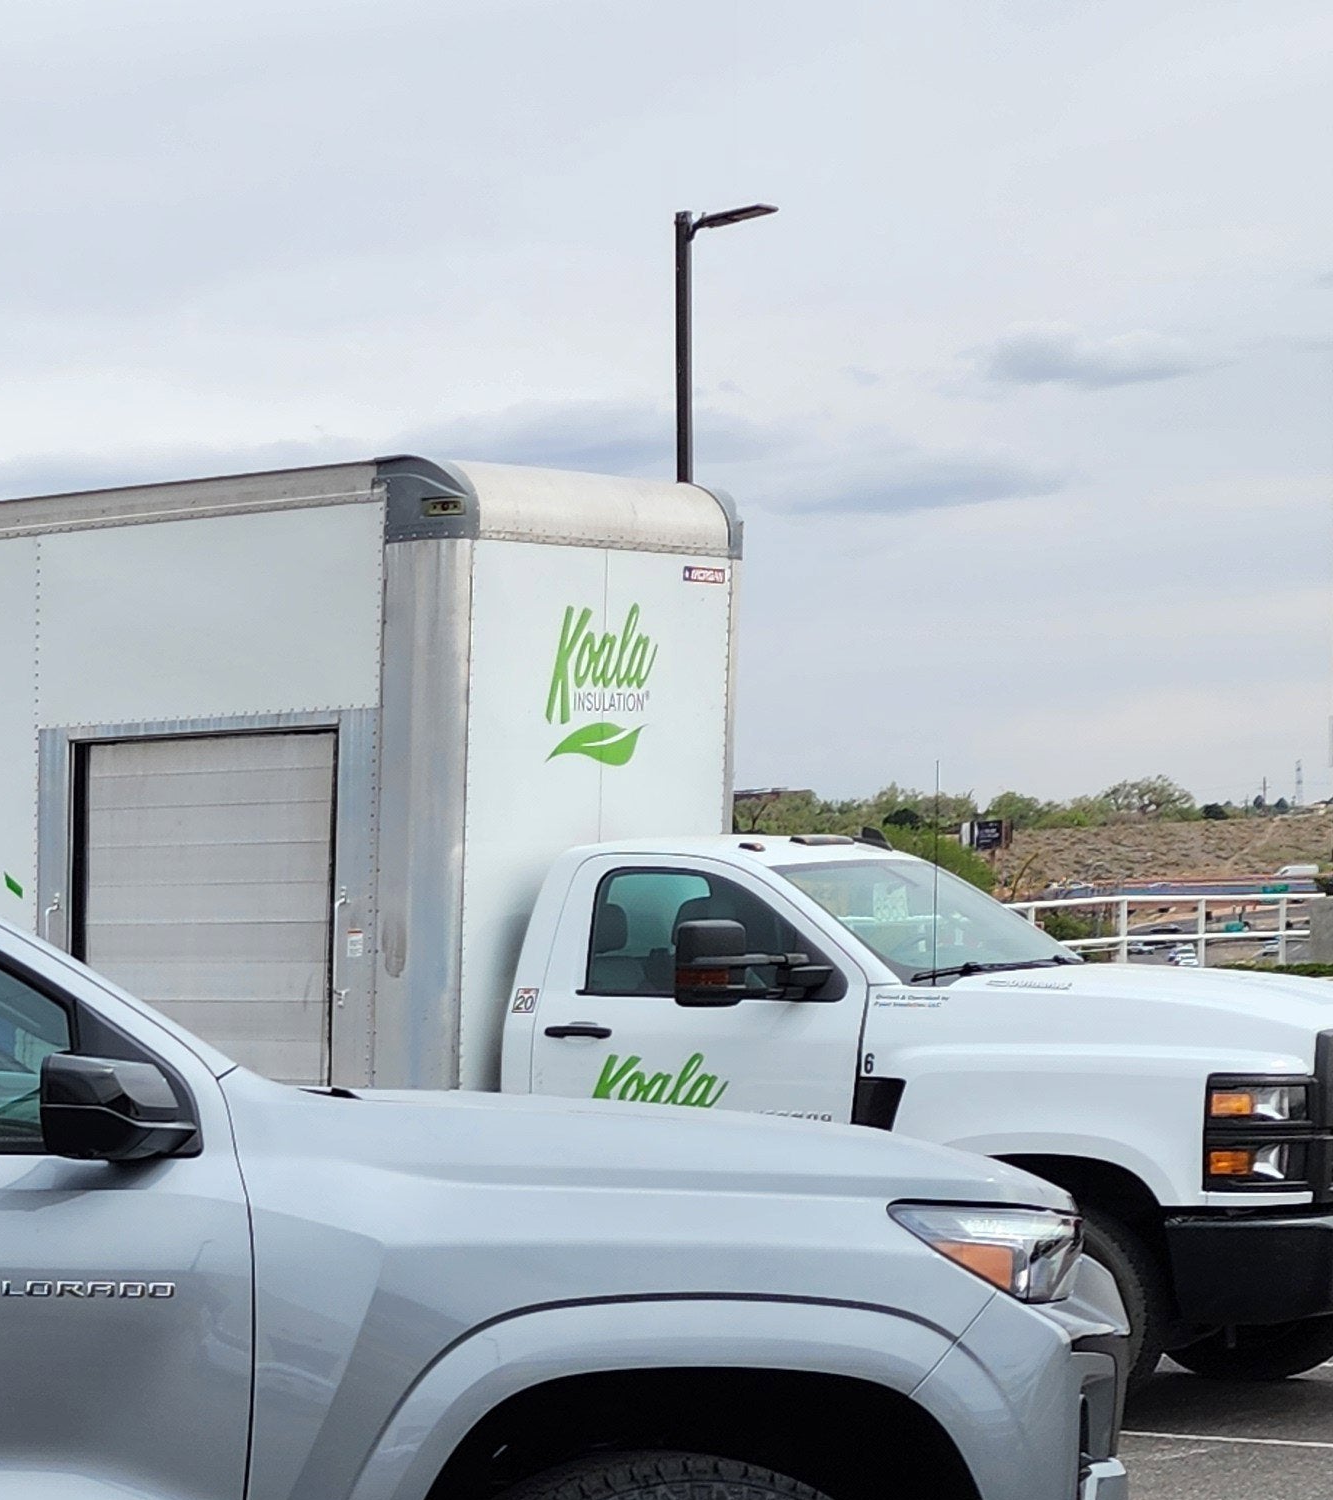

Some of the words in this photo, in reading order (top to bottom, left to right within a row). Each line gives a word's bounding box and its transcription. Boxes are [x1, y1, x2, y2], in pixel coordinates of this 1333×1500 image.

[545, 602, 659, 725] Koala
[515, 995, 534, 1010] 20
[592, 1052, 730, 1108] Koala
[864, 1053, 875, 1074] 6
